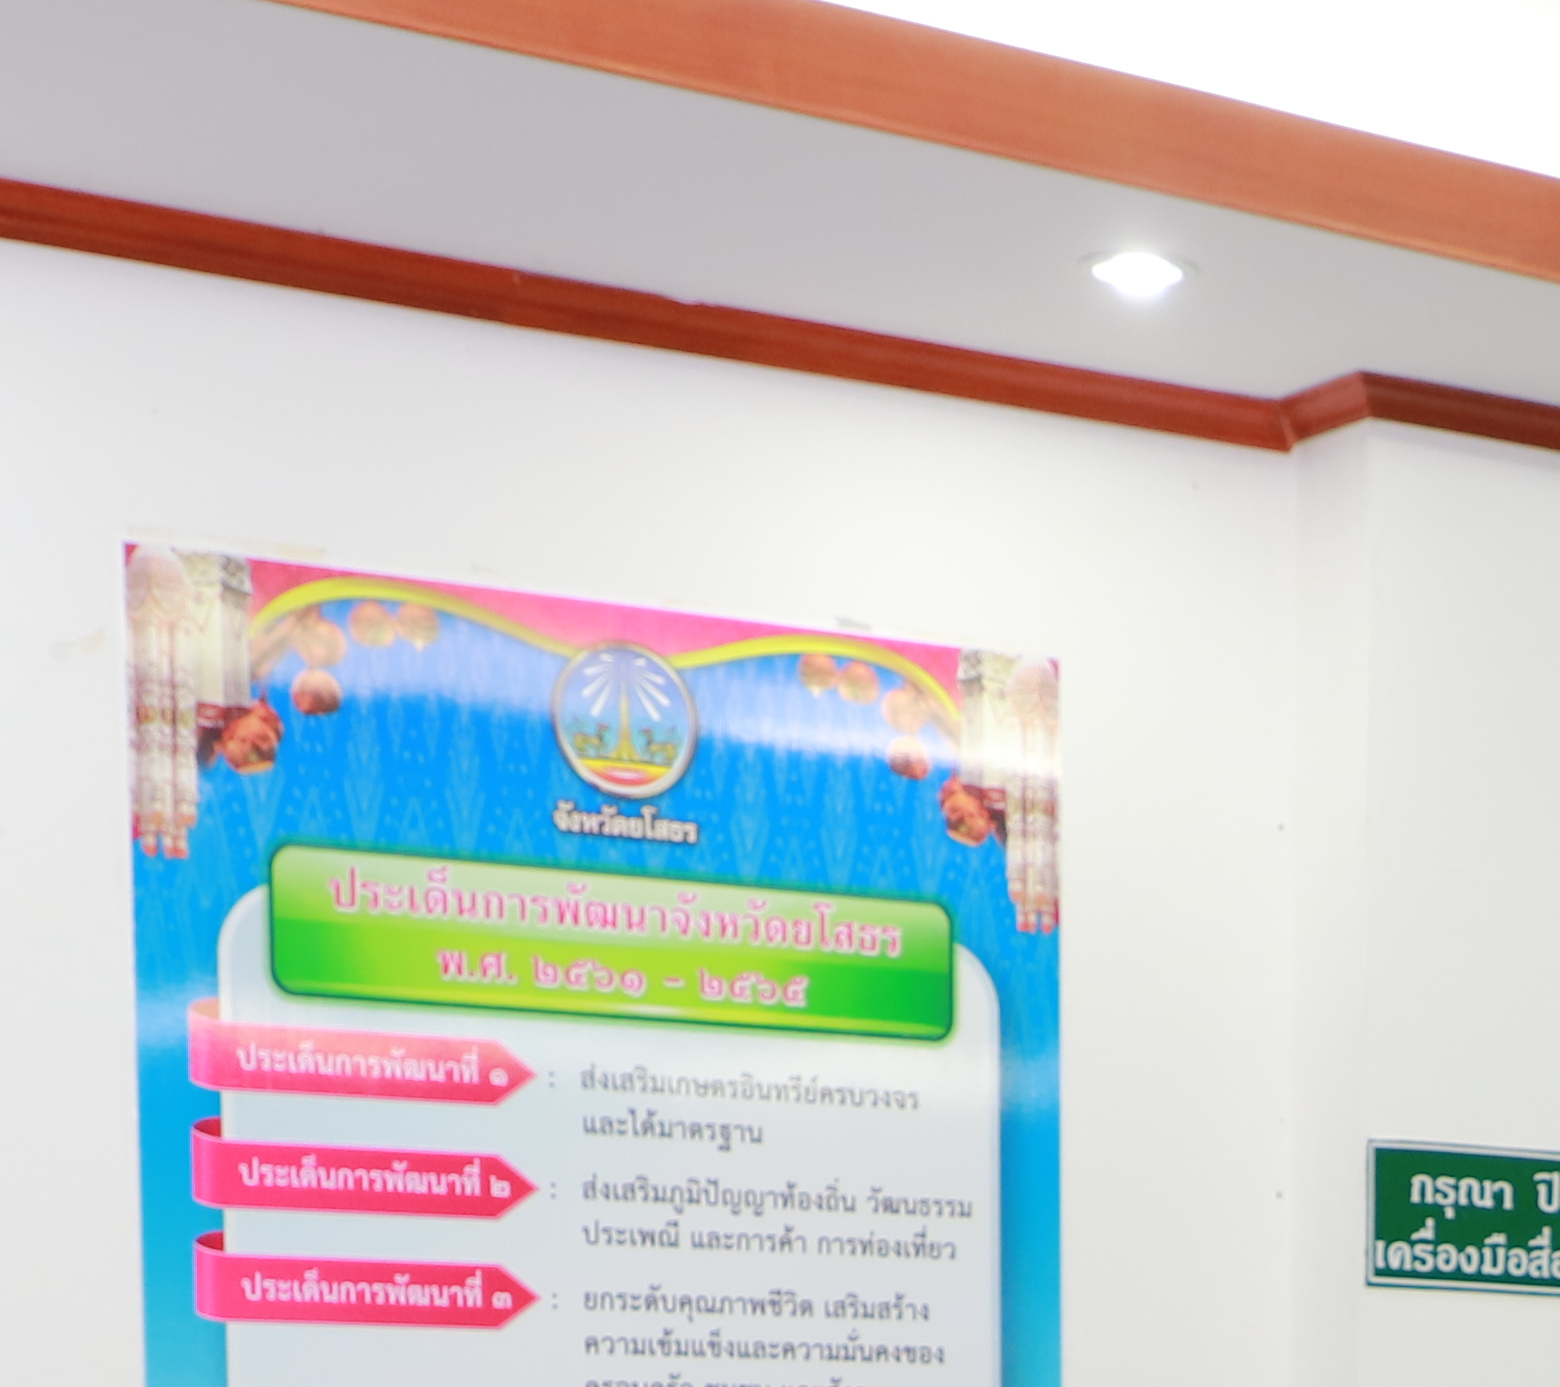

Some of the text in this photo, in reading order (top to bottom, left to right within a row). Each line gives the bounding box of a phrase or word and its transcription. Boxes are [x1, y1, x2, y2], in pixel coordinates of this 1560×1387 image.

[551, 801, 699, 844] จังหวัดยโสธร
[329, 864, 902, 956] ประเด็นการพัฒนาจังหวัดยโสธร
[437, 947, 516, 983] พ.ศ.
[532, 952, 646, 994] ๒๕๖๑
[697, 965, 809, 1008] ๒๕๖๕
[236, 1039, 480, 1085] ประเด็นการพัฒนาที่
[580, 1064, 920, 1111] ส่งเสริมเกษตรอินทรีย์ครบวงจร
[582, 1107, 763, 1152] และได้มาตรฐาน
[239, 1154, 511, 1198] ประเด็นการพัฒนาที่ ๒
[581, 1173, 856, 1216] ส่งเสริมภูมิปัญญาท้องถิ่น
[866, 1187, 972, 1218] วัฒนธรรม
[1410, 1174, 1514, 1219] กรุณา
[582, 1221, 956, 1261] ประเพณี และการค้า การท่องเที่ยว
[241, 1267, 482, 1308] ประเด็นการพัฒนาที่
[583, 1284, 814, 1324] ยกระดับคุณภาพชีวิต
[825, 1292, 930, 1322] เสริมสร้าง
[584, 1327, 945, 1365] ความเข้มแข็งและความมั่นคงของ
